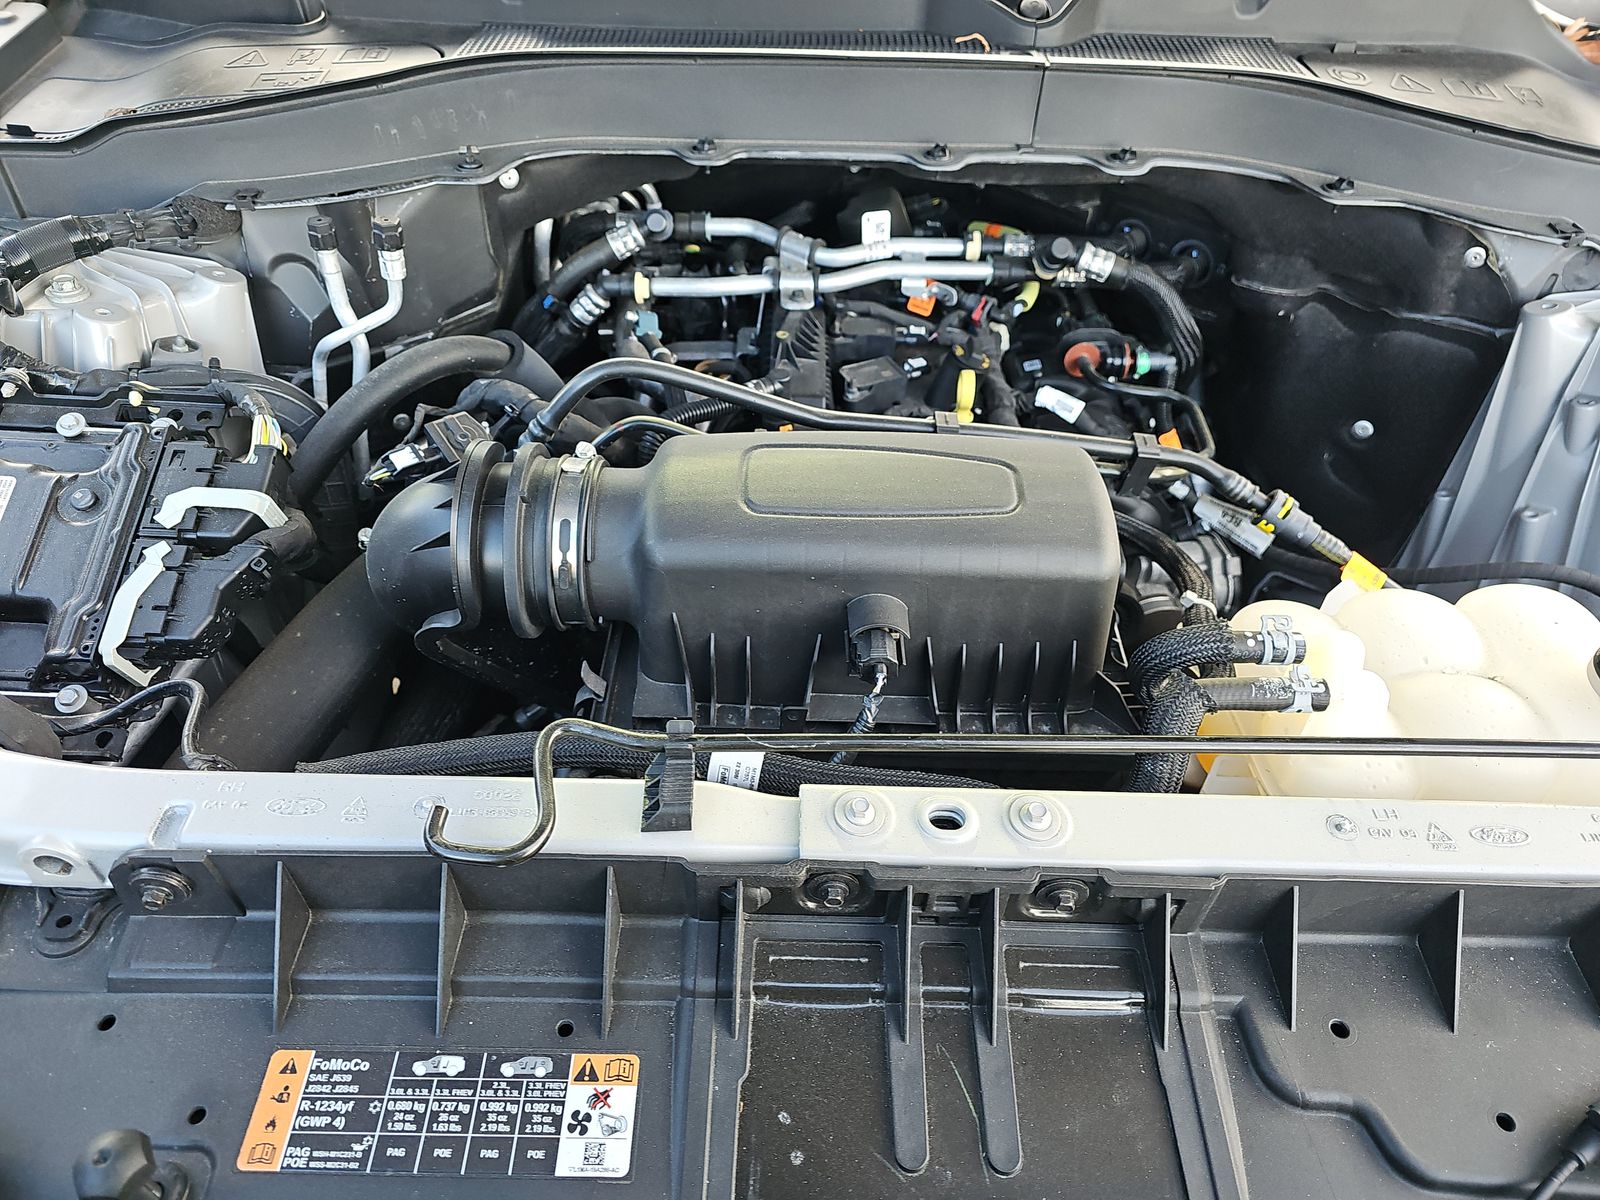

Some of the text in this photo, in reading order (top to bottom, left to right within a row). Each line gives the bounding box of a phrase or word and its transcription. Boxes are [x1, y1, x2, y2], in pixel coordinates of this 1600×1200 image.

[1371, 807, 1401, 822] LH
[311, 1058, 370, 1071] FoMoCo
[308, 1073, 330, 1082] SAE
[545, 1082, 566, 1090] FHEV
[496, 1089, 503, 1097] &
[300, 1100, 355, 1114] R-1234yf
[413, 1101, 426, 1113] kg
[431, 1101, 470, 1114] 0.737 kg
[479, 1102, 518, 1114] 0.992 kg
[524, 1103, 563, 1115] 0.992 kg
[486, 1113, 497, 1121] 35
[531, 1115, 542, 1123] 35
[295, 1115, 346, 1130] (GWP 4)
[403, 1122, 417, 1131] lbs
[432, 1123, 462, 1132] 1.63 lbs
[479, 1123, 511, 1132] 2.19 lbs
[525, 1124, 556, 1133] 2.19 lbs
[286, 1146, 311, 1157] PAG
[385, 1147, 407, 1157] PAG
[433, 1148, 453, 1158] POE
[479, 1149, 500, 1159] PAG
[526, 1150, 546, 1160] POE
[282, 1157, 309, 1168] POE
